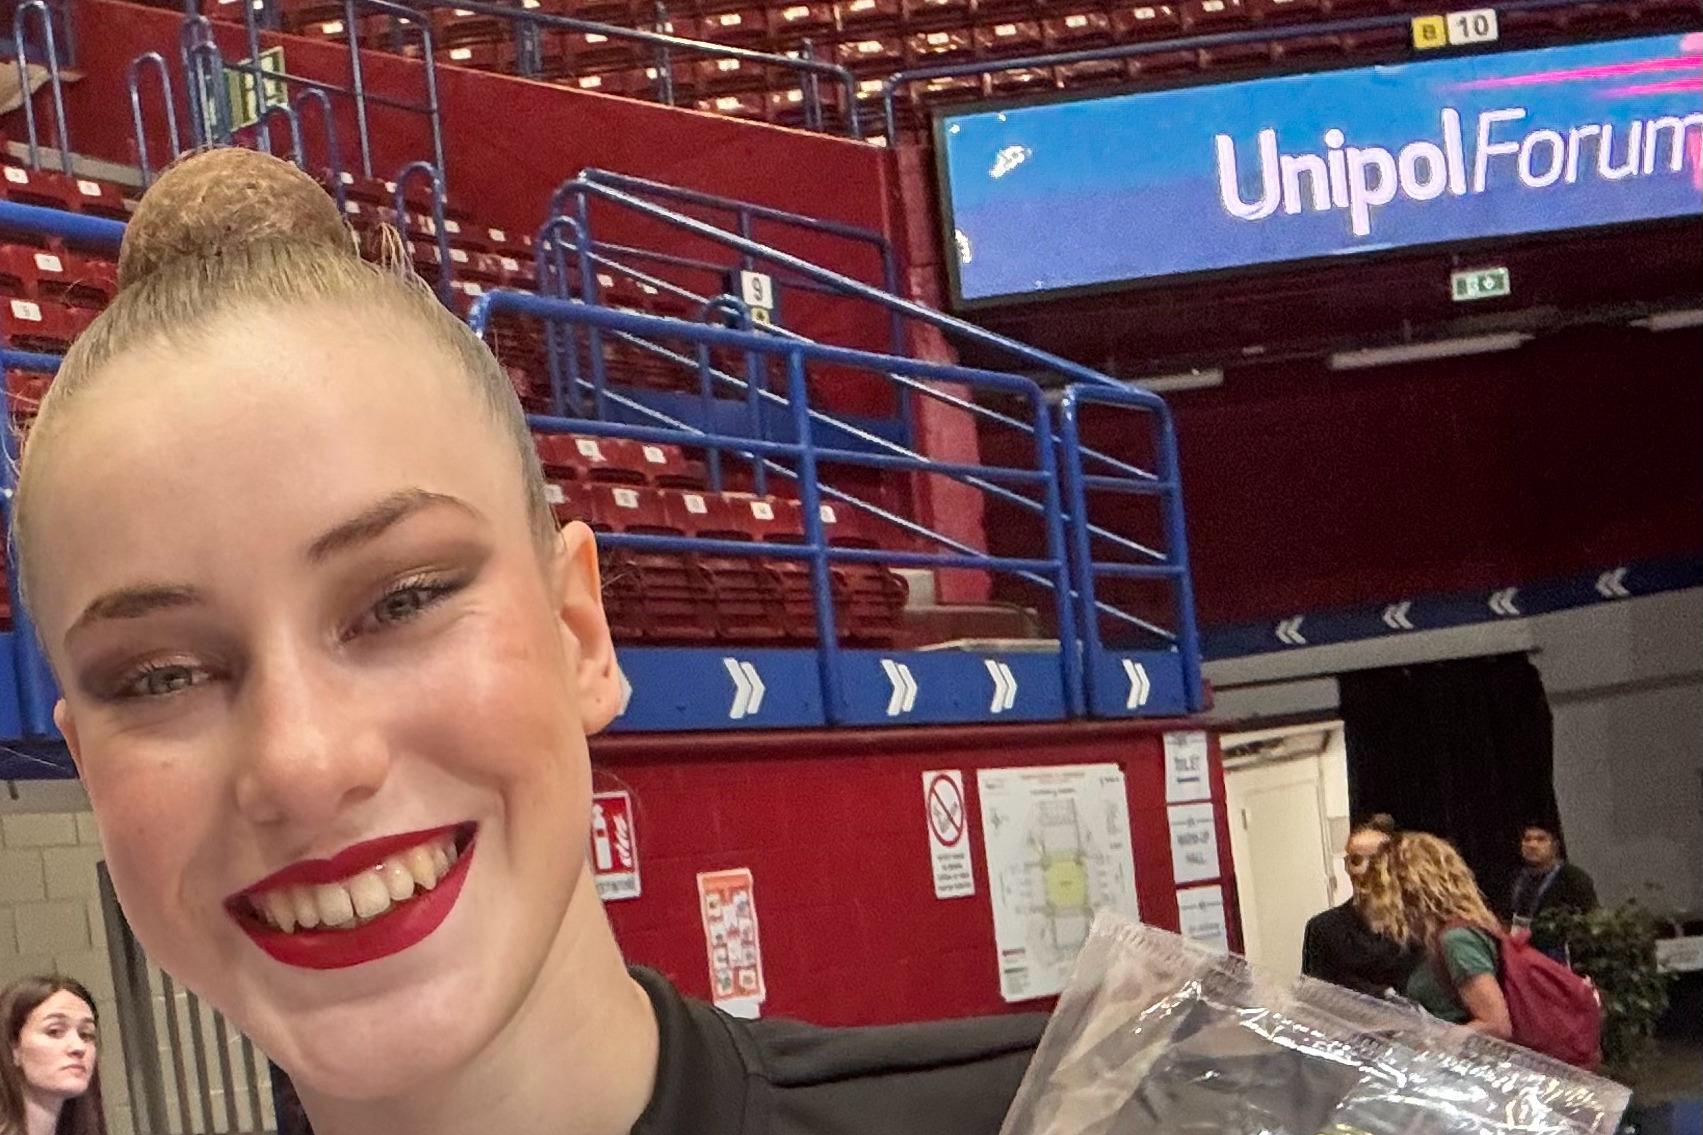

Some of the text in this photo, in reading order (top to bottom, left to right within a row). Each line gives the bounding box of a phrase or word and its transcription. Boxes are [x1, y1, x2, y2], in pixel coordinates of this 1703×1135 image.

[1456, 14, 1490, 38] 10
[1214, 106, 1703, 237] UnipolForum
[751, 276, 764, 302] 9
